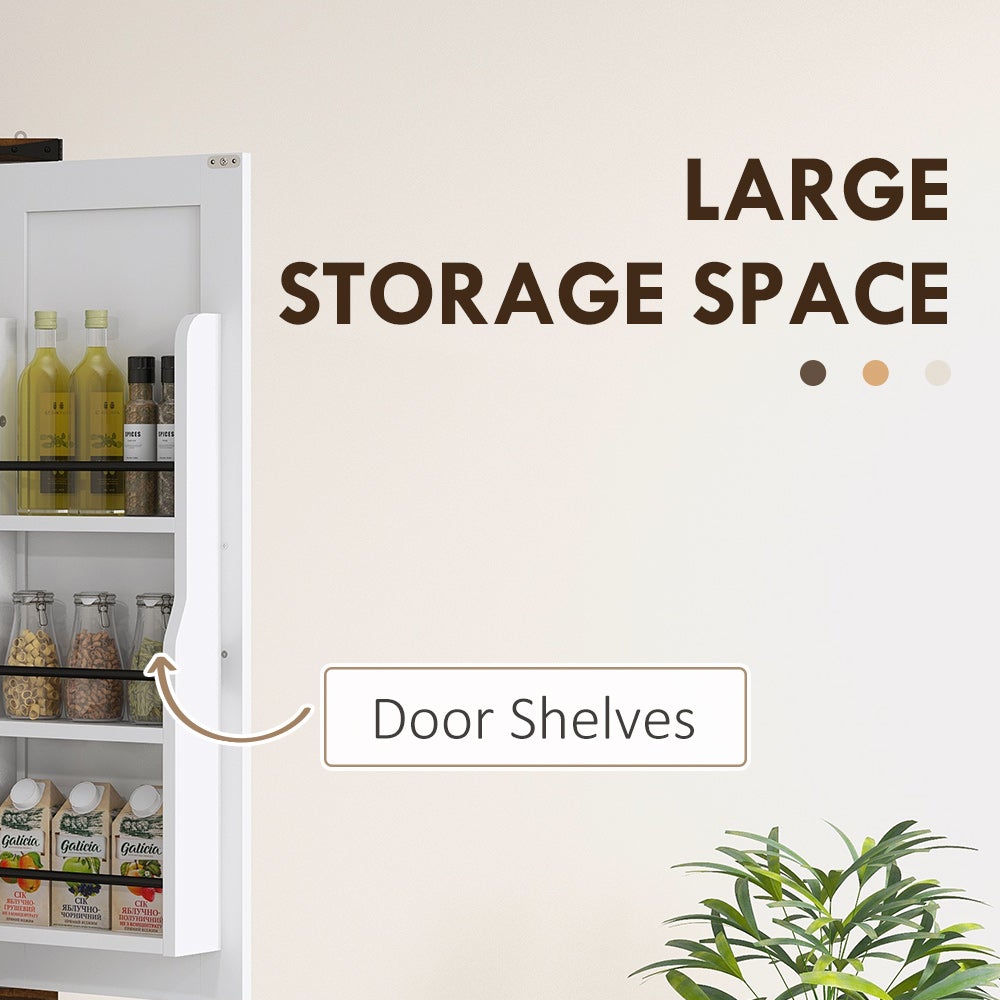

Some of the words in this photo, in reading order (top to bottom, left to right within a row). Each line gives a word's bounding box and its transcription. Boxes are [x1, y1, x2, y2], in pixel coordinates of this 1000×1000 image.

[1, 834, 40, 849] Galicia
[60, 839, 102, 854] Galicia
[120, 841, 163, 856] Galicia
